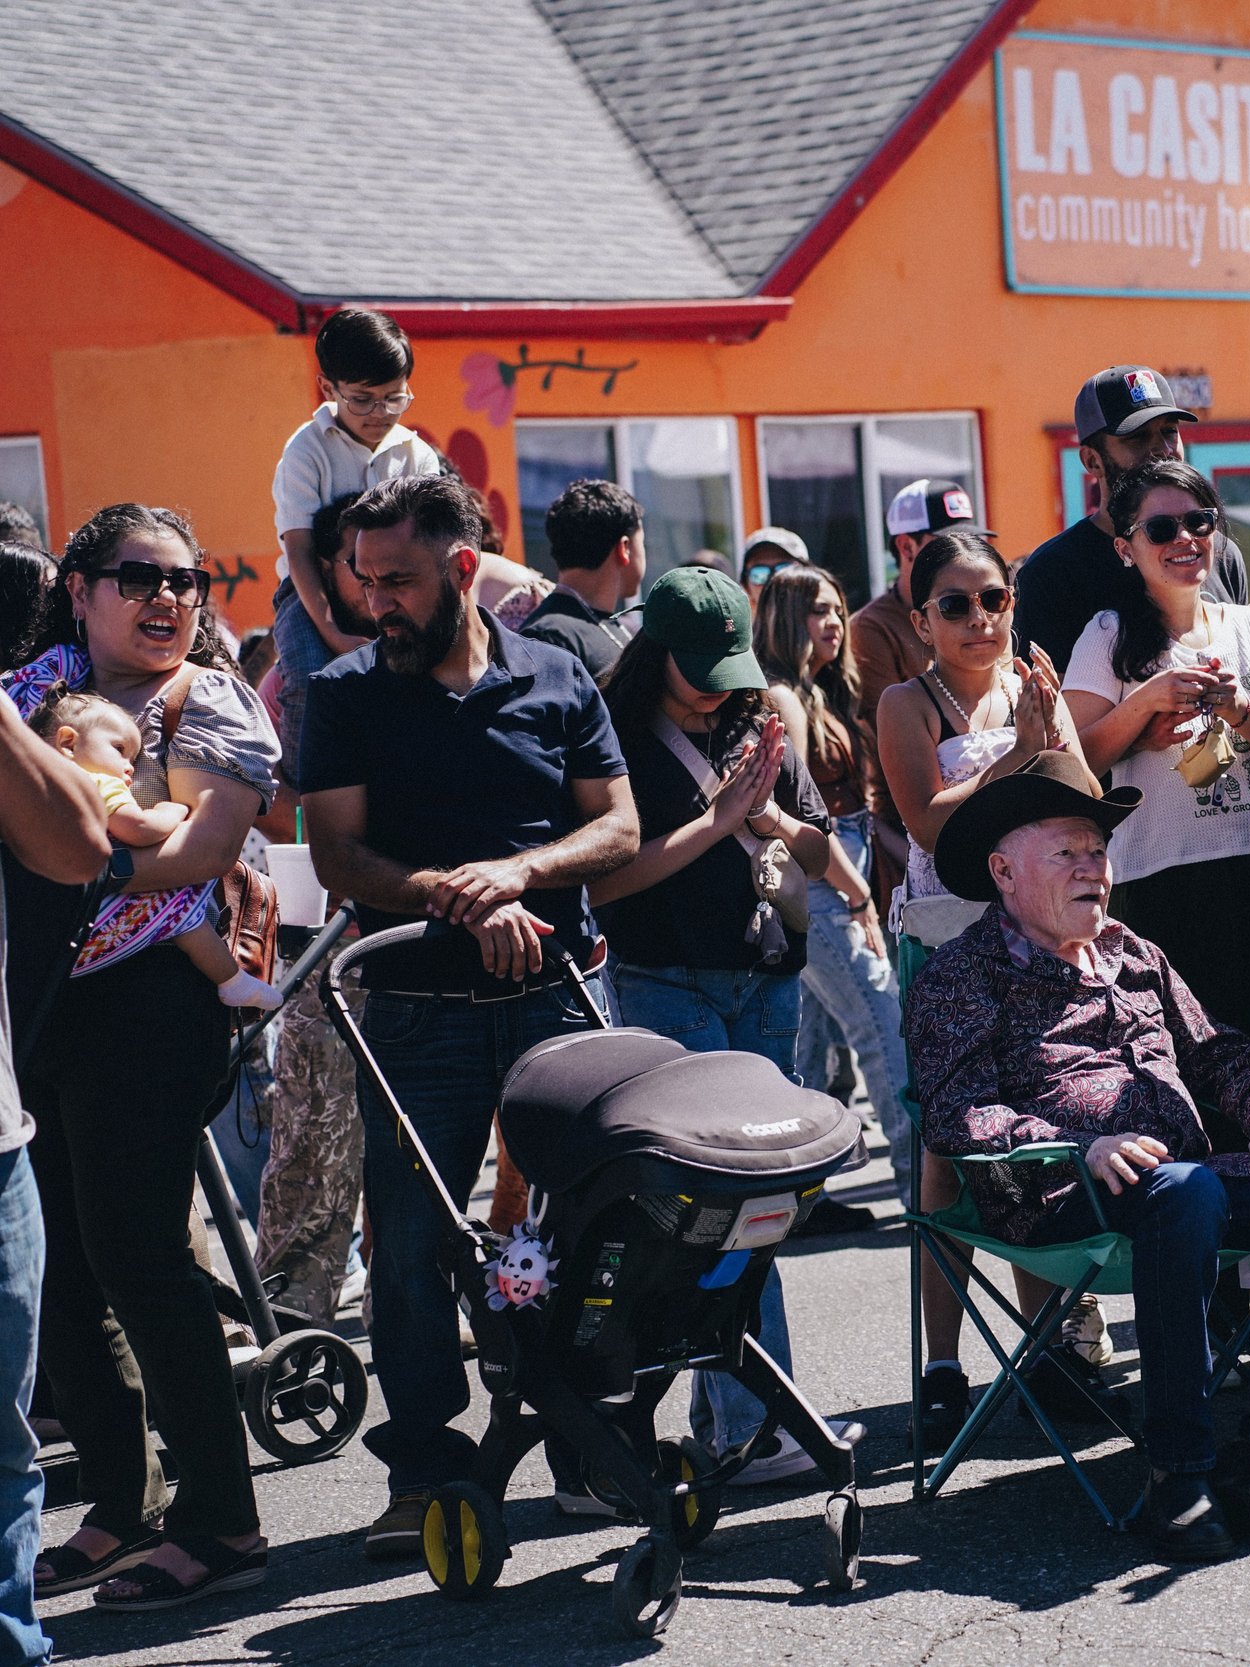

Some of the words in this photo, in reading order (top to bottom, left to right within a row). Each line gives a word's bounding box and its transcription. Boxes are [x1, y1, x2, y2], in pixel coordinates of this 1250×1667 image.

[1012, 66, 1093, 176] LA
[1016, 187, 1207, 268] community
[1194, 807, 1219, 819] LOVE
